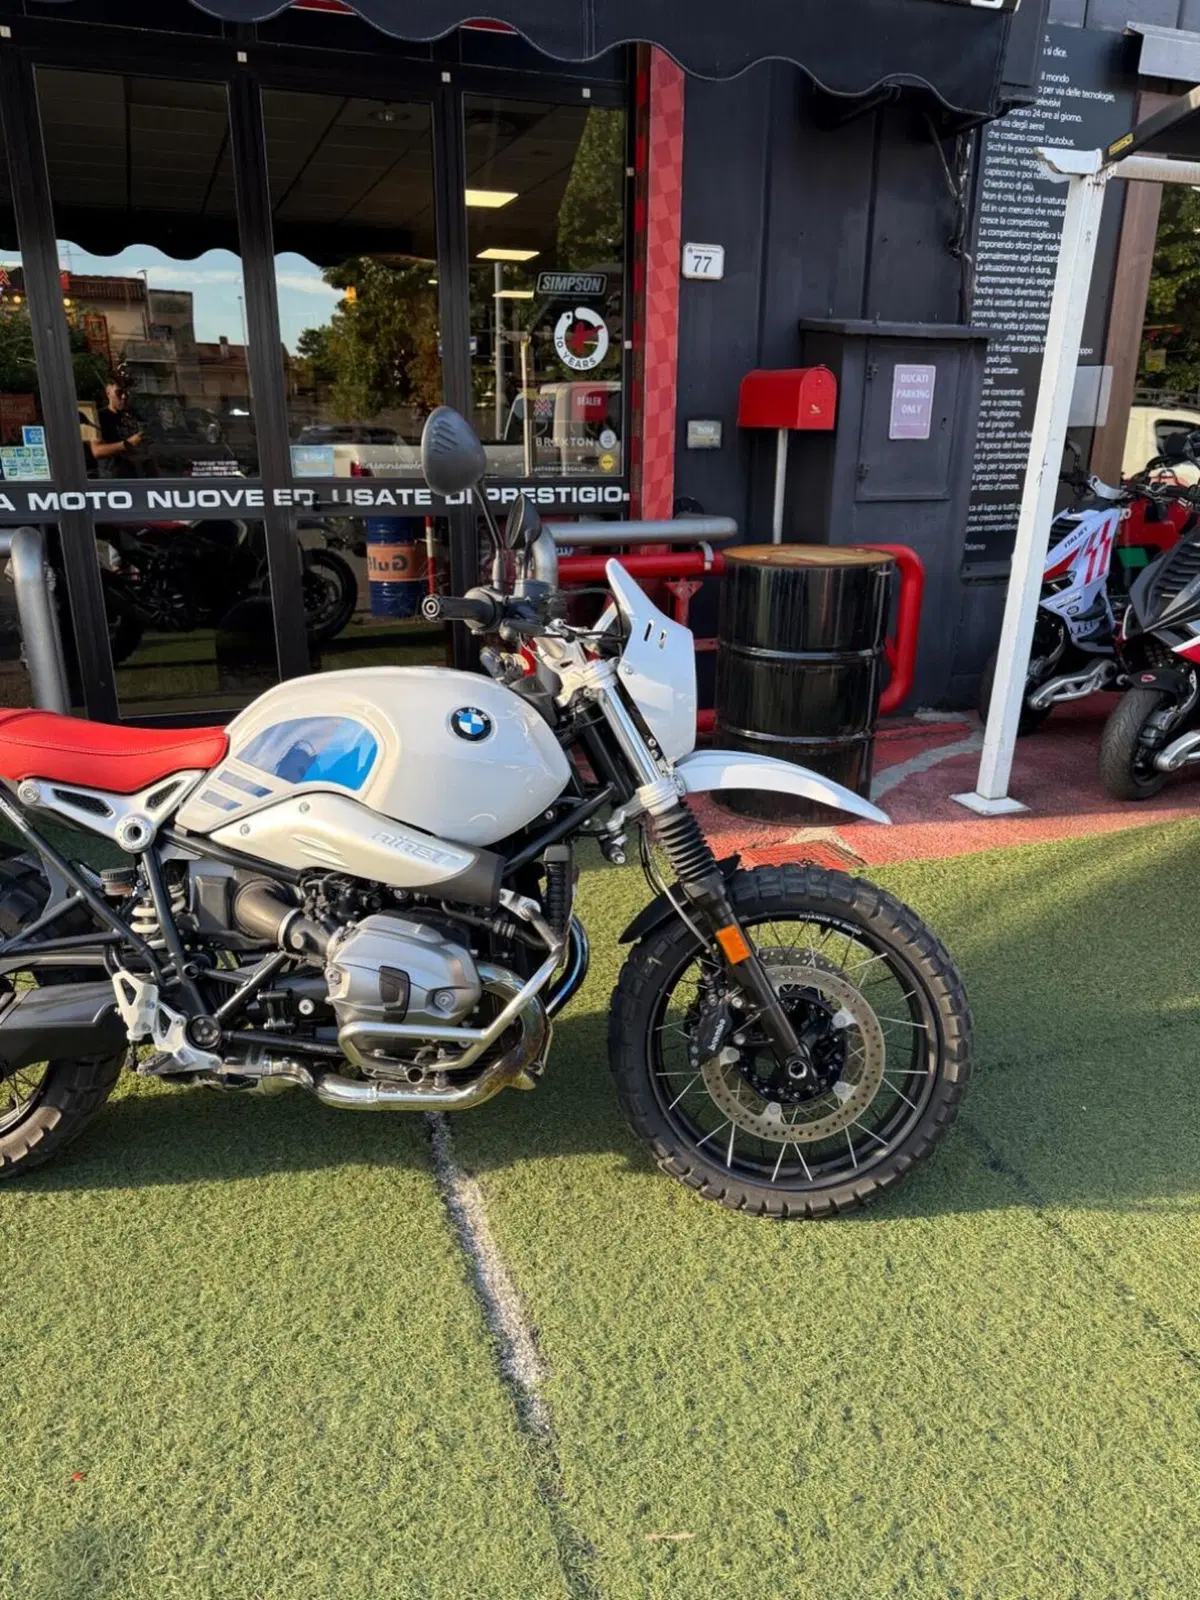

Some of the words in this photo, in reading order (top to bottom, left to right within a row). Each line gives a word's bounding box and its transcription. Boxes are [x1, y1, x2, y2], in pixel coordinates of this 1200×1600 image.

[1046, 73, 1070, 83] mondo
[1043, 86, 1055, 95] per
[1055, 87, 1066, 95] via
[1066, 87, 1081, 98] delle
[1036, 97, 1061, 108] elevisivi
[1032, 109, 1041, 118] 24
[1042, 110, 1053, 119] ore
[1053, 110, 1060, 119] al
[1060, 112, 1083, 122] giorno.
[1001, 119, 1011, 127] via
[1011, 119, 1028, 131] degli
[1029, 121, 1045, 131] aerei
[988, 130, 1000, 139] che
[1000, 131, 1026, 142] costano
[1026, 134, 1044, 143] come
[1007, 143, 1014, 153] le
[983, 179, 1014, 189] Chiedono
[1015, 181, 1021, 190] di
[982, 191, 996, 201] Non
[1034, 195, 1041, 204] di
[981, 203, 990, 212] Ed
[991, 204, 997, 213] in
[1008, 206, 1034, 216] mercato
[1035, 207, 1046, 216] che
[1047, 208, 1065, 217] matur
[980, 217, 999, 225] cresce
[1000, 216, 1006, 225] la
[979, 227, 986, 236] La
[987, 228, 1030, 239] competizione
[1030, 230, 1056, 241] migliora
[978, 239, 1015, 250] imponendo
[1033, 243, 1044, 252] per
[693, 255, 712, 274] 77
[975, 263, 983, 271] La
[984, 263, 1016, 273] situazione
[1016, 265, 1030, 273] non
[542, 275, 603, 292] SIMPSON
[979, 275, 1024, 285] estremamente
[994, 286, 1013, 296] molto
[1024, 299, 1039, 308] stare
[1003, 320, 1018, 330] volta
[562, 351, 596, 369] YEARS
[900, 372, 929, 383] DUCATI
[895, 388, 930, 399] PARKING
[576, 396, 603, 406] DEALER
[901, 404, 923, 414] ONLY
[28, 489, 134, 512] MOTO
[147, 488, 265, 509] NUOVE
[273, 487, 316, 507] ED
[332, 487, 432, 507] USATE
[486, 485, 625, 505] PRESTIGIO
[456, 707, 490, 722] BMW
